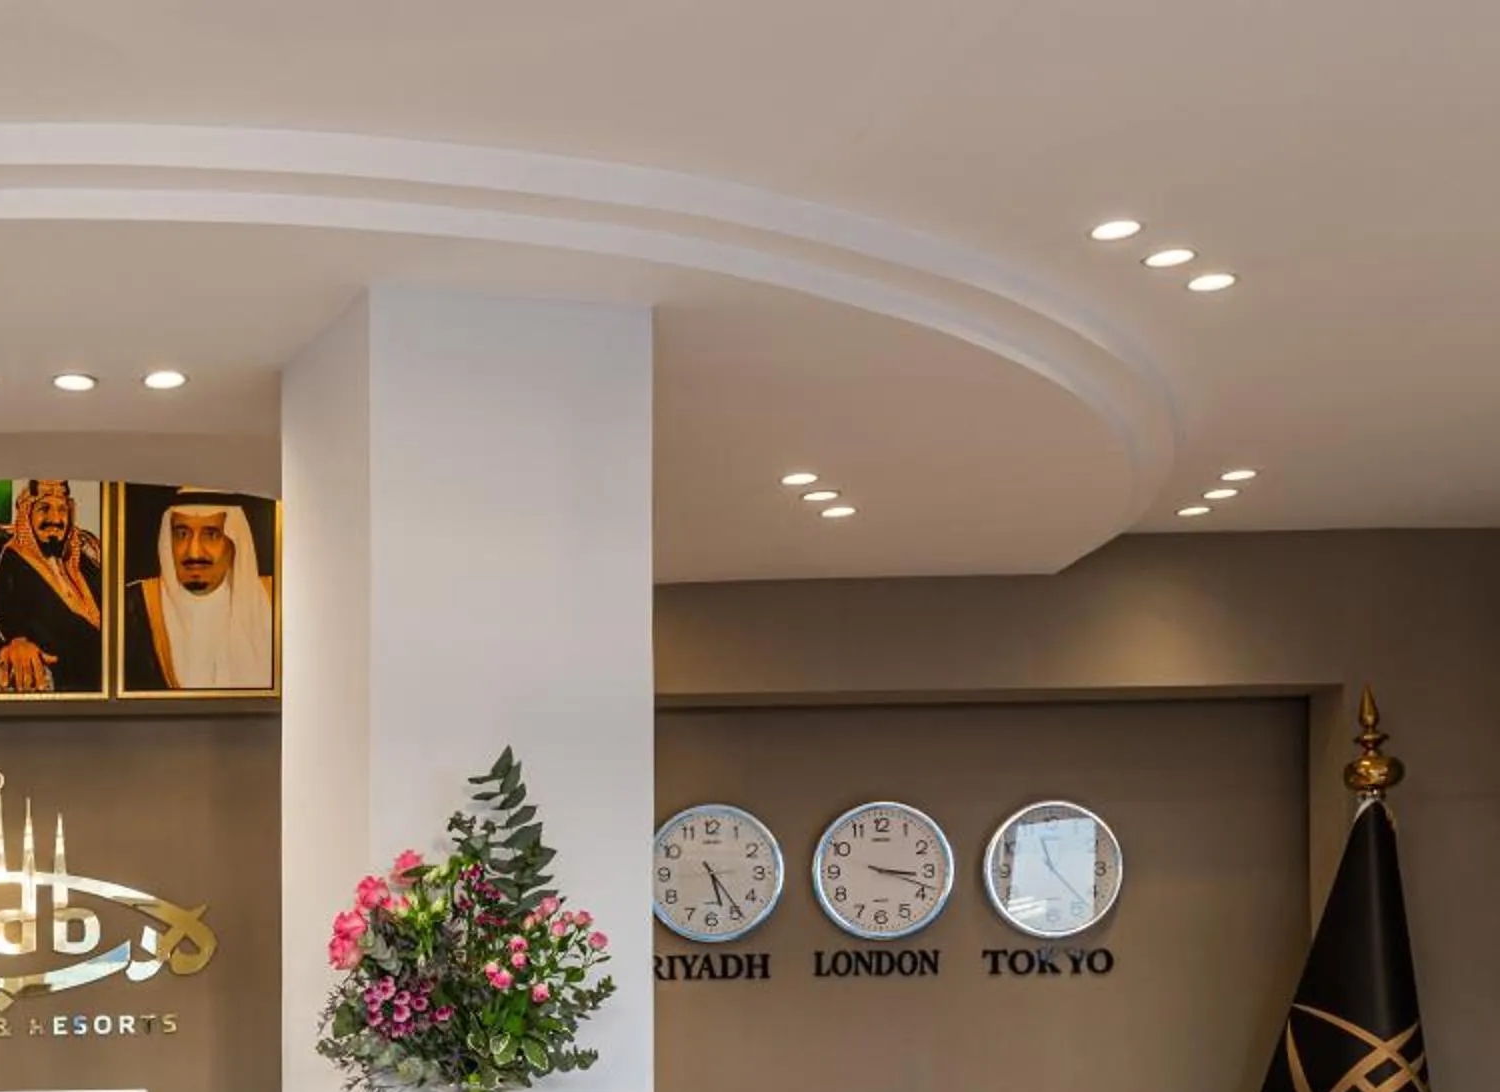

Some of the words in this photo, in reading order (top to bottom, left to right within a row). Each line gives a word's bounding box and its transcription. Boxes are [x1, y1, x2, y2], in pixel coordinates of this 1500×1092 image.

[705, 819, 720, 835] 12
[851, 822, 864, 838] 11
[874, 817, 890, 832] 12
[902, 823, 908, 837] 1
[681, 825, 694, 841] 11
[733, 826, 739, 840] 1
[746, 843, 759, 859] 2
[833, 841, 851, 857] 10
[915, 840, 928, 855] 2
[657, 867, 671, 882] 9
[753, 866, 765, 881] 3
[827, 864, 841, 879] 9
[923, 863, 935, 879] 3
[1094, 861, 1107, 876] 3
[665, 889, 678, 904] 8
[745, 888, 757, 902] 4
[834, 885, 847, 902] 8
[915, 885, 926, 900] 4
[684, 907, 696, 921] 7
[853, 904, 865, 919] 7
[873, 909, 889, 925] 6
[899, 903, 911, 919] 5
[705, 912, 719, 927] 6
[814, 949, 940, 977] LONDON
[983, 947, 1114, 976] TOKYO
